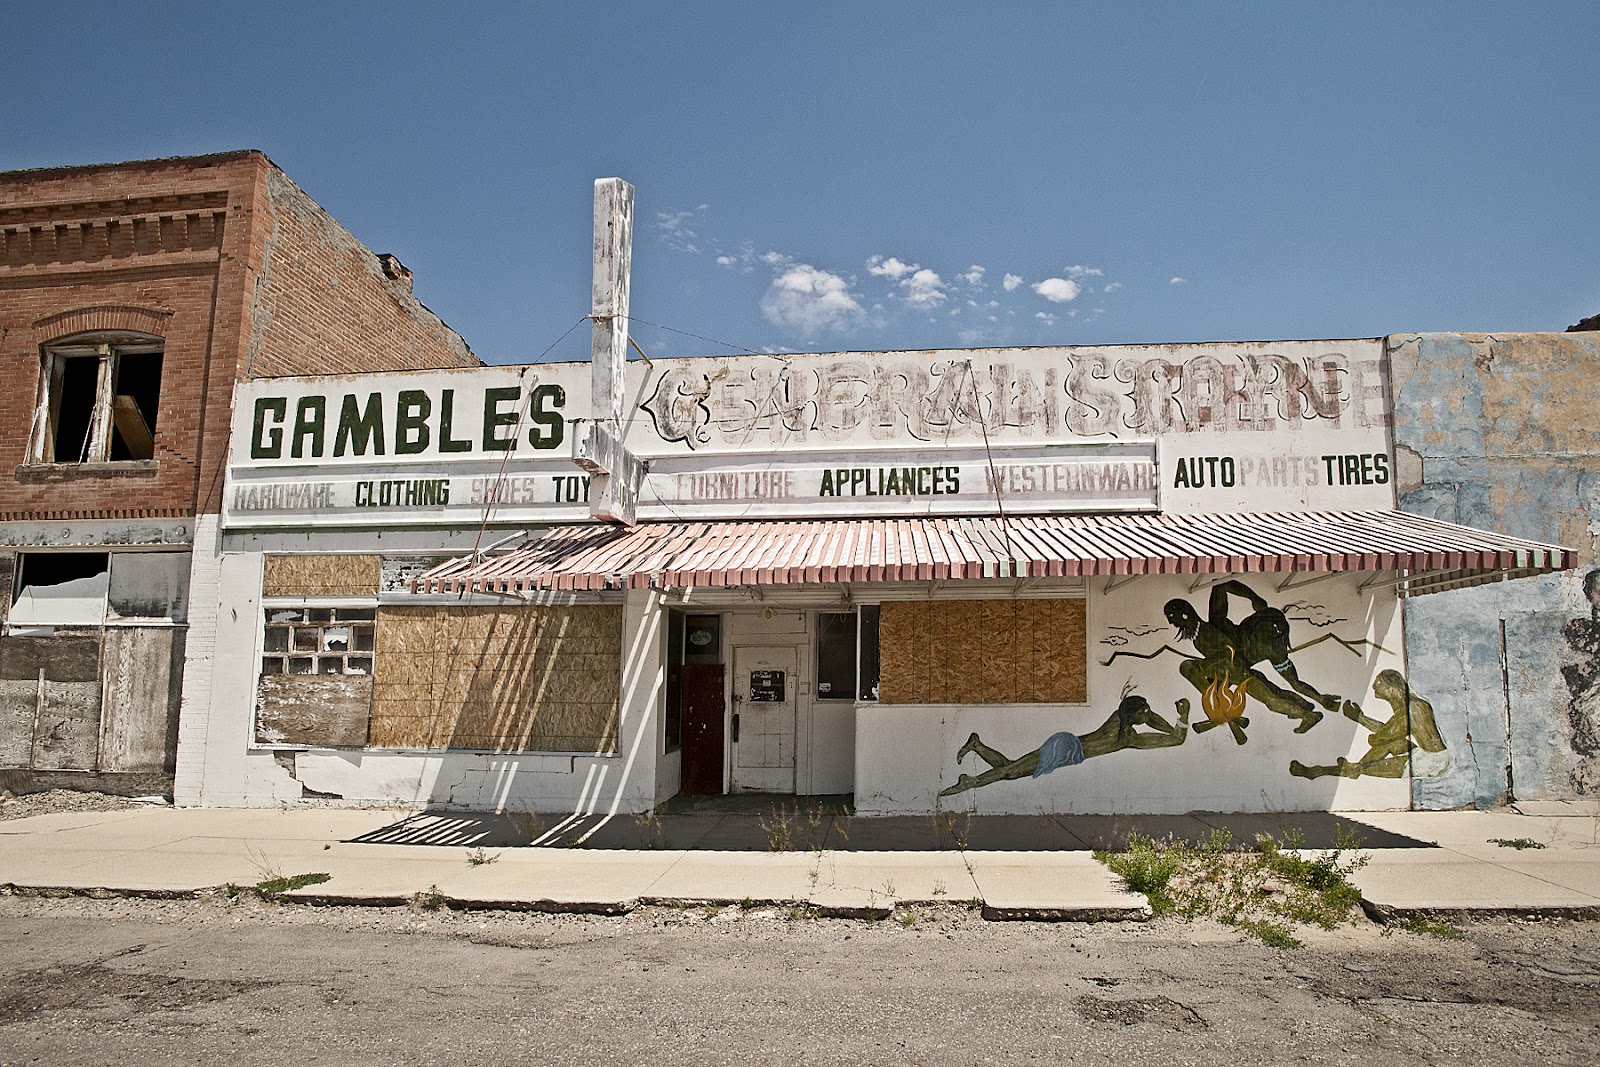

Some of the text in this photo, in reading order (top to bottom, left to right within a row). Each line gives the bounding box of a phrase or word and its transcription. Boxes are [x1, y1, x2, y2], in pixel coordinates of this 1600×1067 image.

[250, 384, 566, 460] GAMBLES
[819, 466, 960, 497] APPLIANCES
[1174, 453, 1389, 488] AUTO PARTS TIRES
[356, 479, 450, 507] CLOTHING
[471, 477, 534, 504] SHOES
